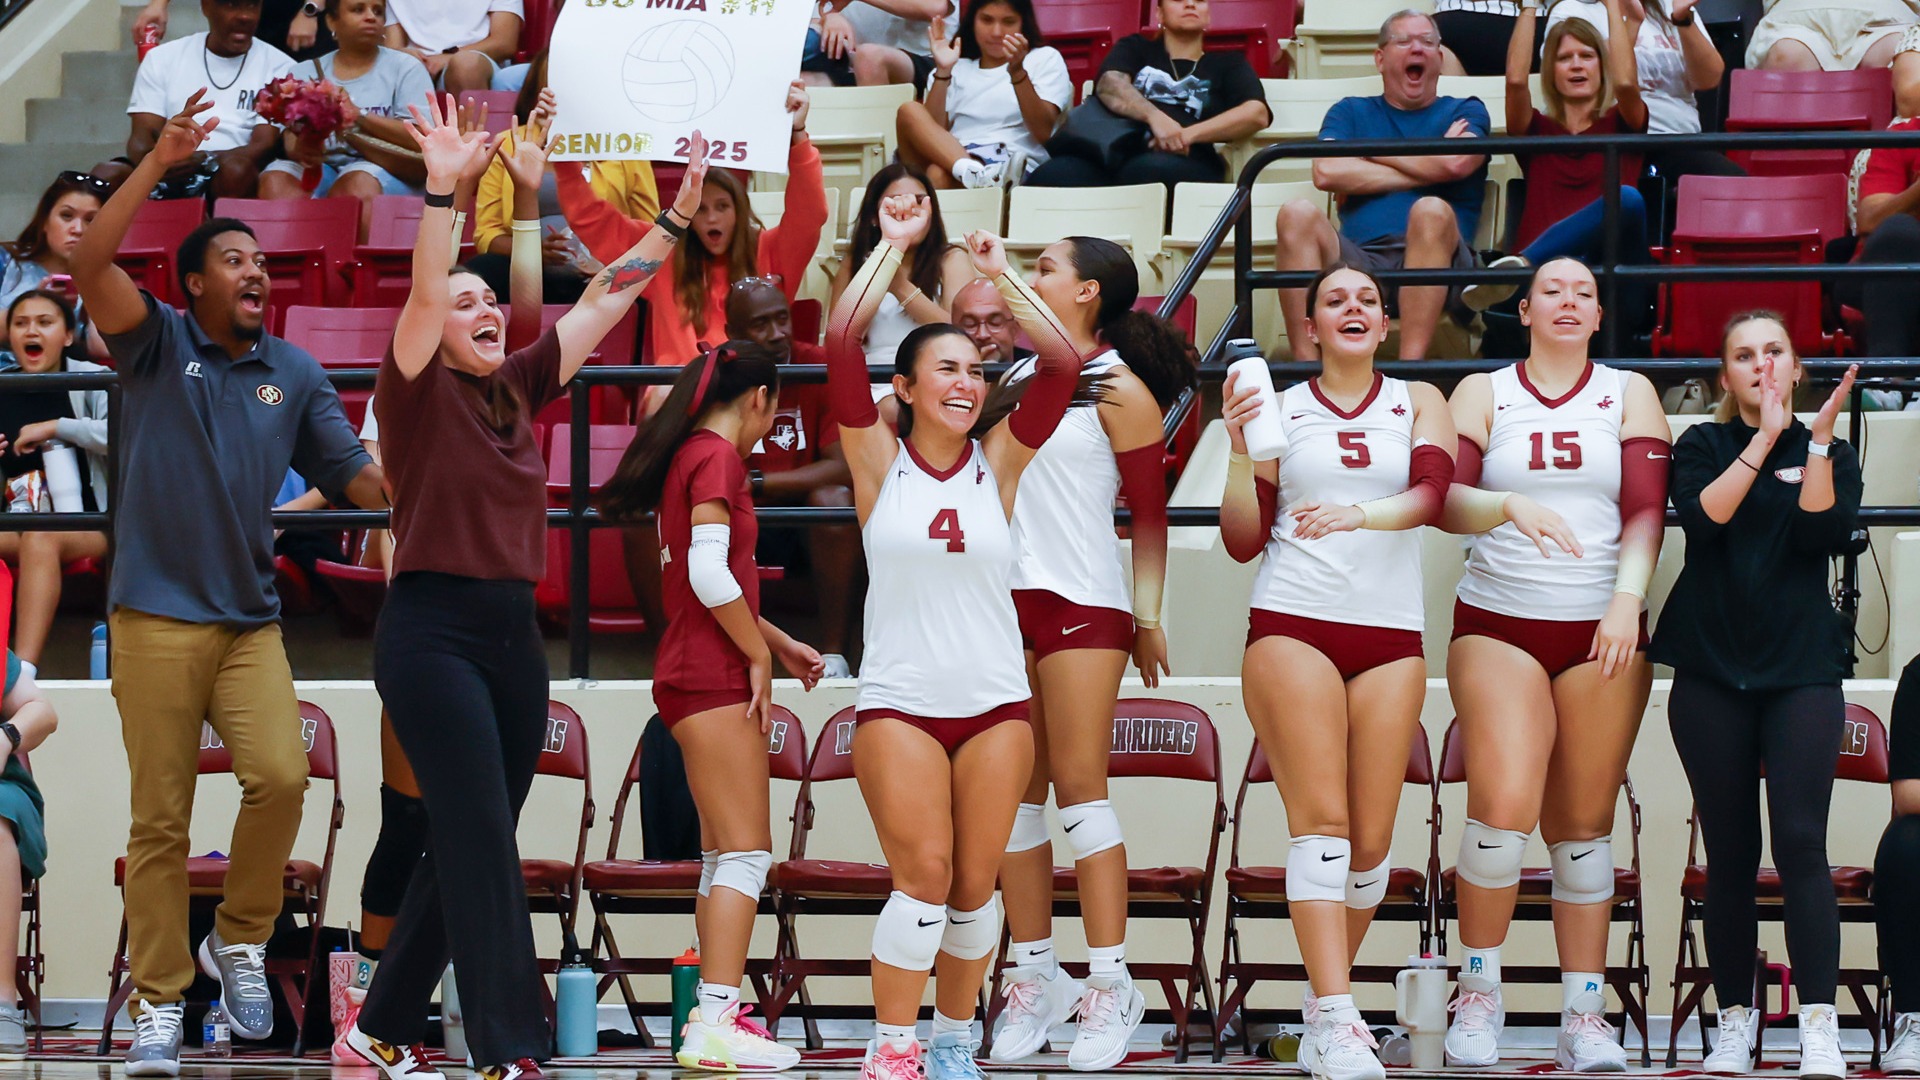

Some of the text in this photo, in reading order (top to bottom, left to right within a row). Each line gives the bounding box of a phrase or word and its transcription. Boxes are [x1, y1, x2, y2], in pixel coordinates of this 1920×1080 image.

[552, 132, 653, 155] SENIOR
[1337, 431, 1372, 469] 5
[1528, 431, 1582, 470] 15
[928, 508, 966, 553] 4
[1129, 718, 1198, 756] RIDERS
